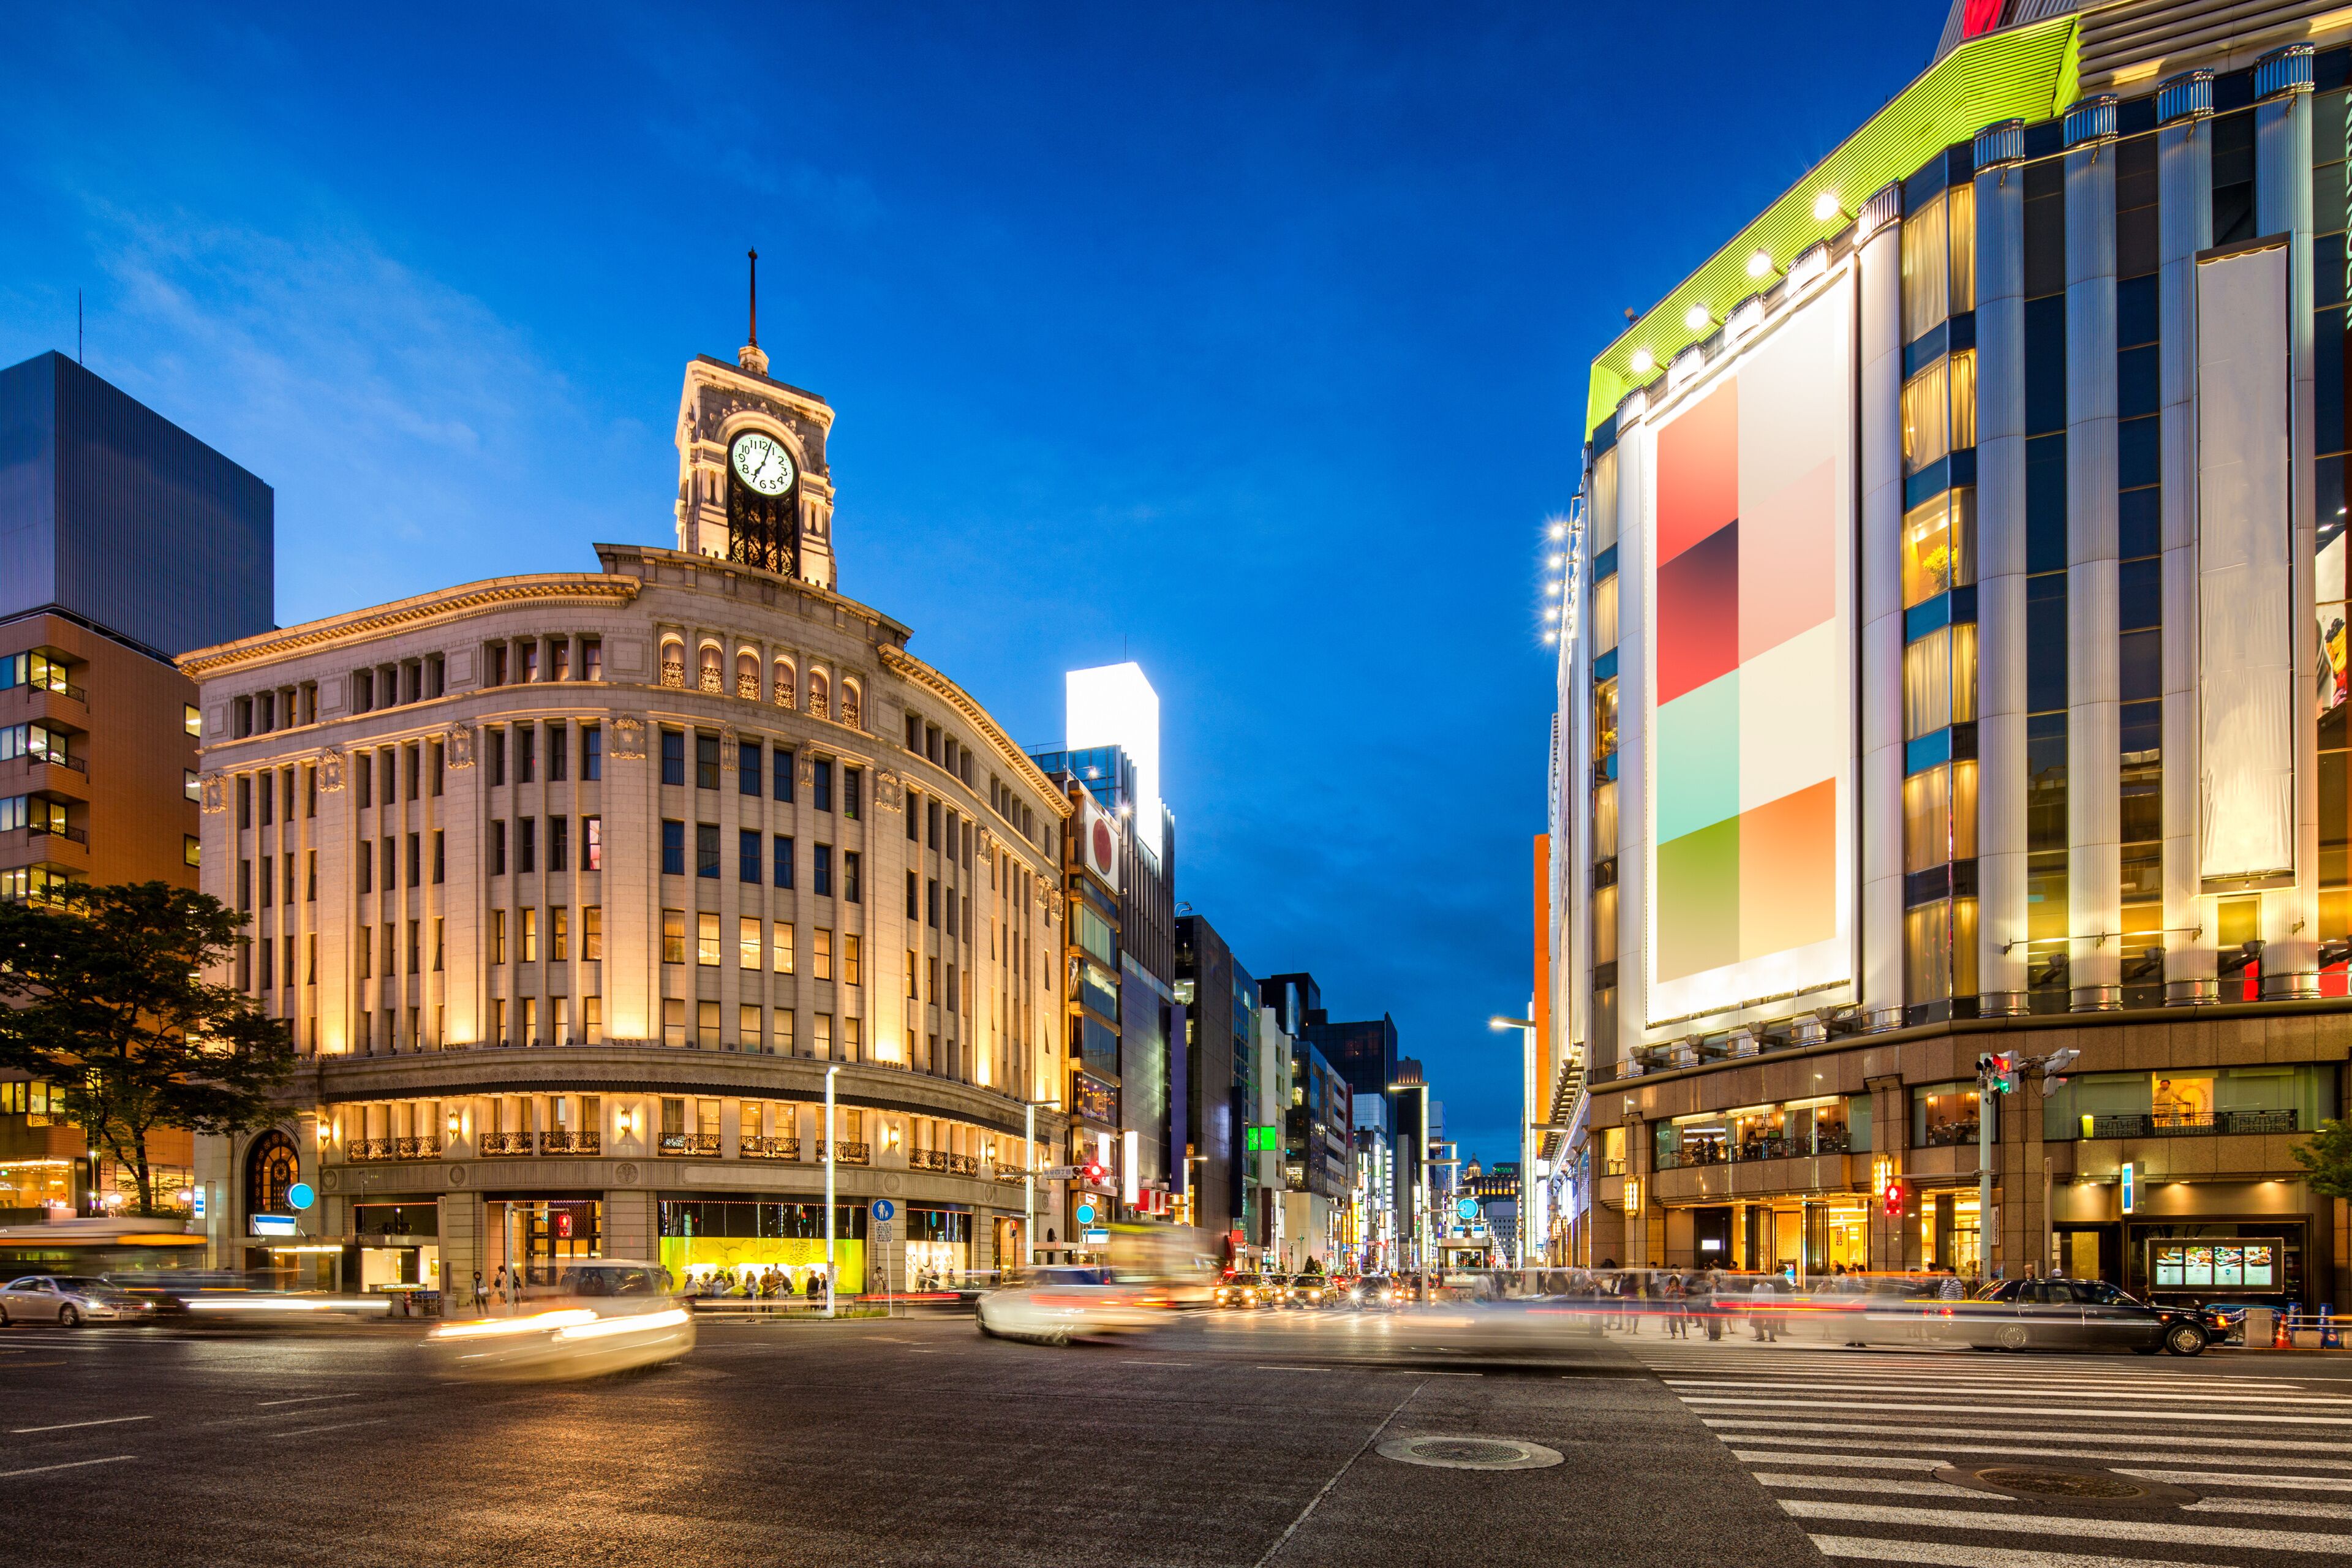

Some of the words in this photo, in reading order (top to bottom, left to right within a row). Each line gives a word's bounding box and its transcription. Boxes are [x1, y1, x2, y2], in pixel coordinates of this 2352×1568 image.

[742, 445, 750, 454] 10
[750, 440, 756, 450] 11
[760, 440, 768, 451] 12
[772, 447, 775, 456] 1
[739, 453, 745, 462] 9
[778, 456, 784, 466] 2
[742, 464, 749, 473] 8
[781, 467, 788, 476] 3
[751, 473, 758, 483] 7
[777, 476, 784, 484] 4
[760, 480, 766, 489] 6
[769, 480, 776, 489] 5
